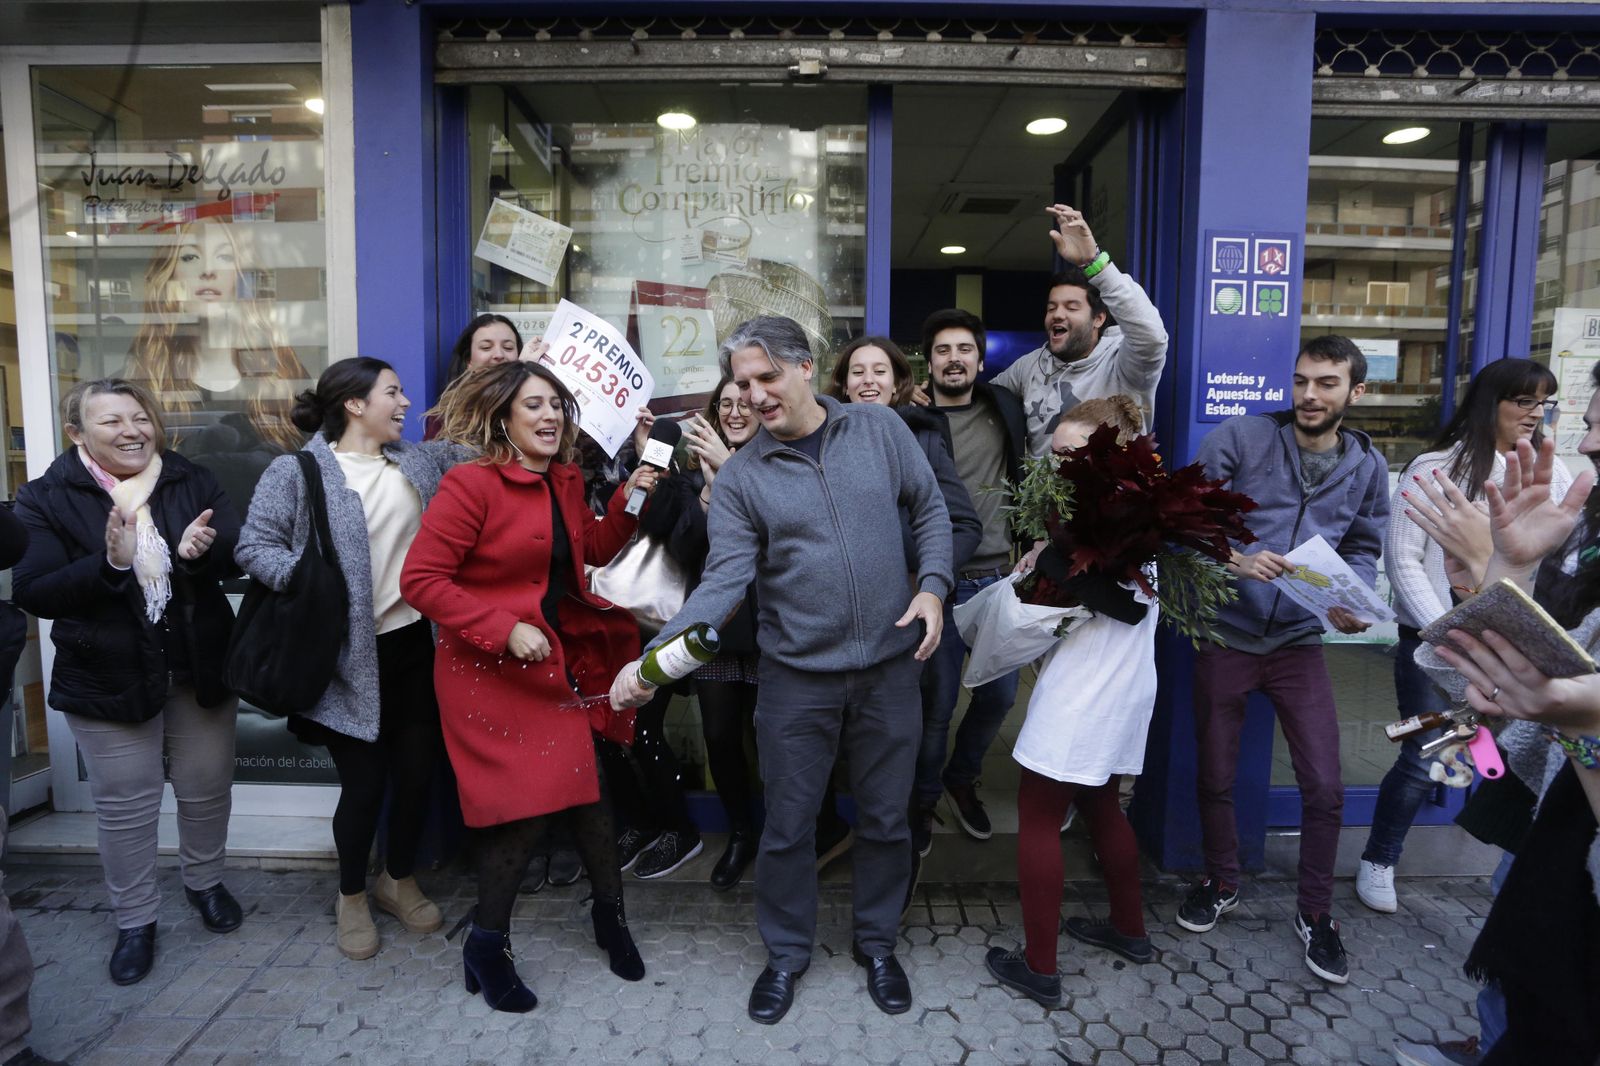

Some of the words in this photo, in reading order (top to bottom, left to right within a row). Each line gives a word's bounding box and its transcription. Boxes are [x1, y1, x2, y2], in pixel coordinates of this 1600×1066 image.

[81, 150, 159, 187] Juan
[165, 148, 286, 201] Delgado
[654, 147, 762, 188] Premio
[618, 179, 807, 228] Compartirlo
[661, 315, 705, 357] 22
[559, 345, 630, 408] 04536
[583, 329, 643, 390] PREMIO
[1207, 372, 1255, 385] Loterías
[1257, 375, 1266, 388] y
[1205, 403, 1247, 416] Estado
[1206, 387, 1262, 402] Apuestas
[1264, 388, 1284, 401] del
[234, 755, 275, 767] mación
[277, 755, 296, 768] del
